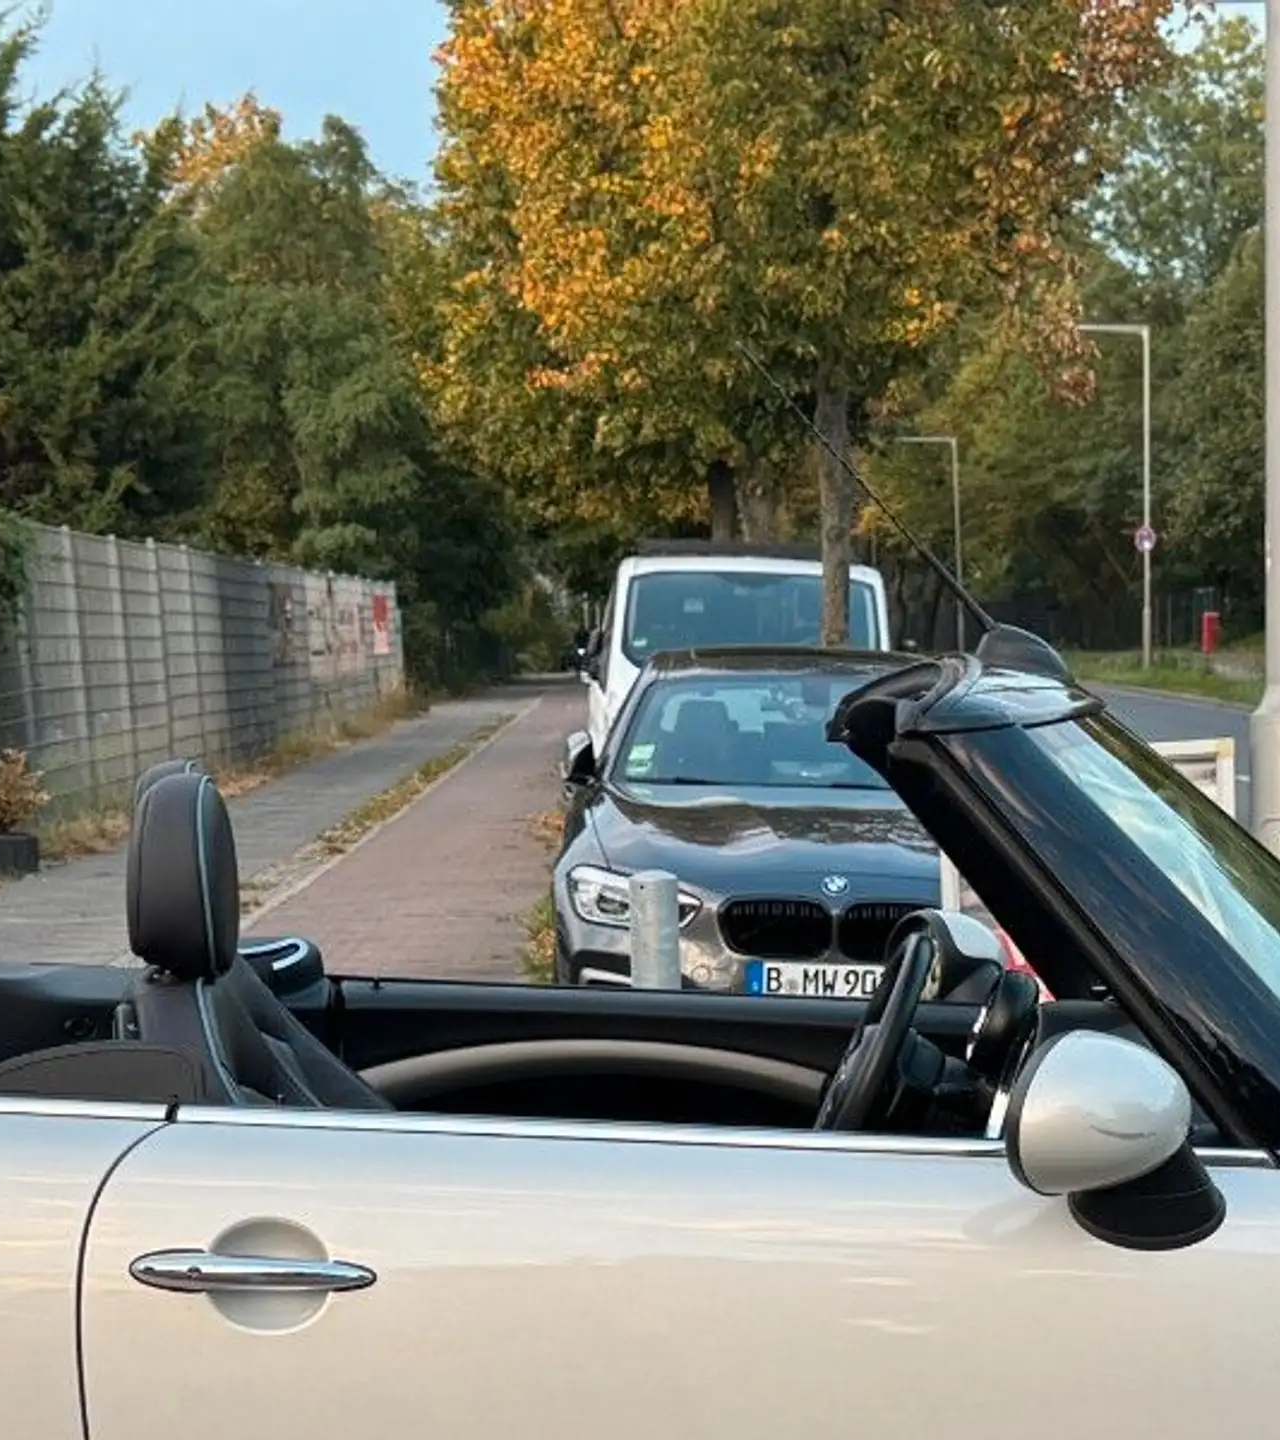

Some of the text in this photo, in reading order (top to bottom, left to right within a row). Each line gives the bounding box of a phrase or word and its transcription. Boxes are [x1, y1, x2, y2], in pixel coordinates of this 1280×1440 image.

[766, 967, 885, 996] B MW 90
